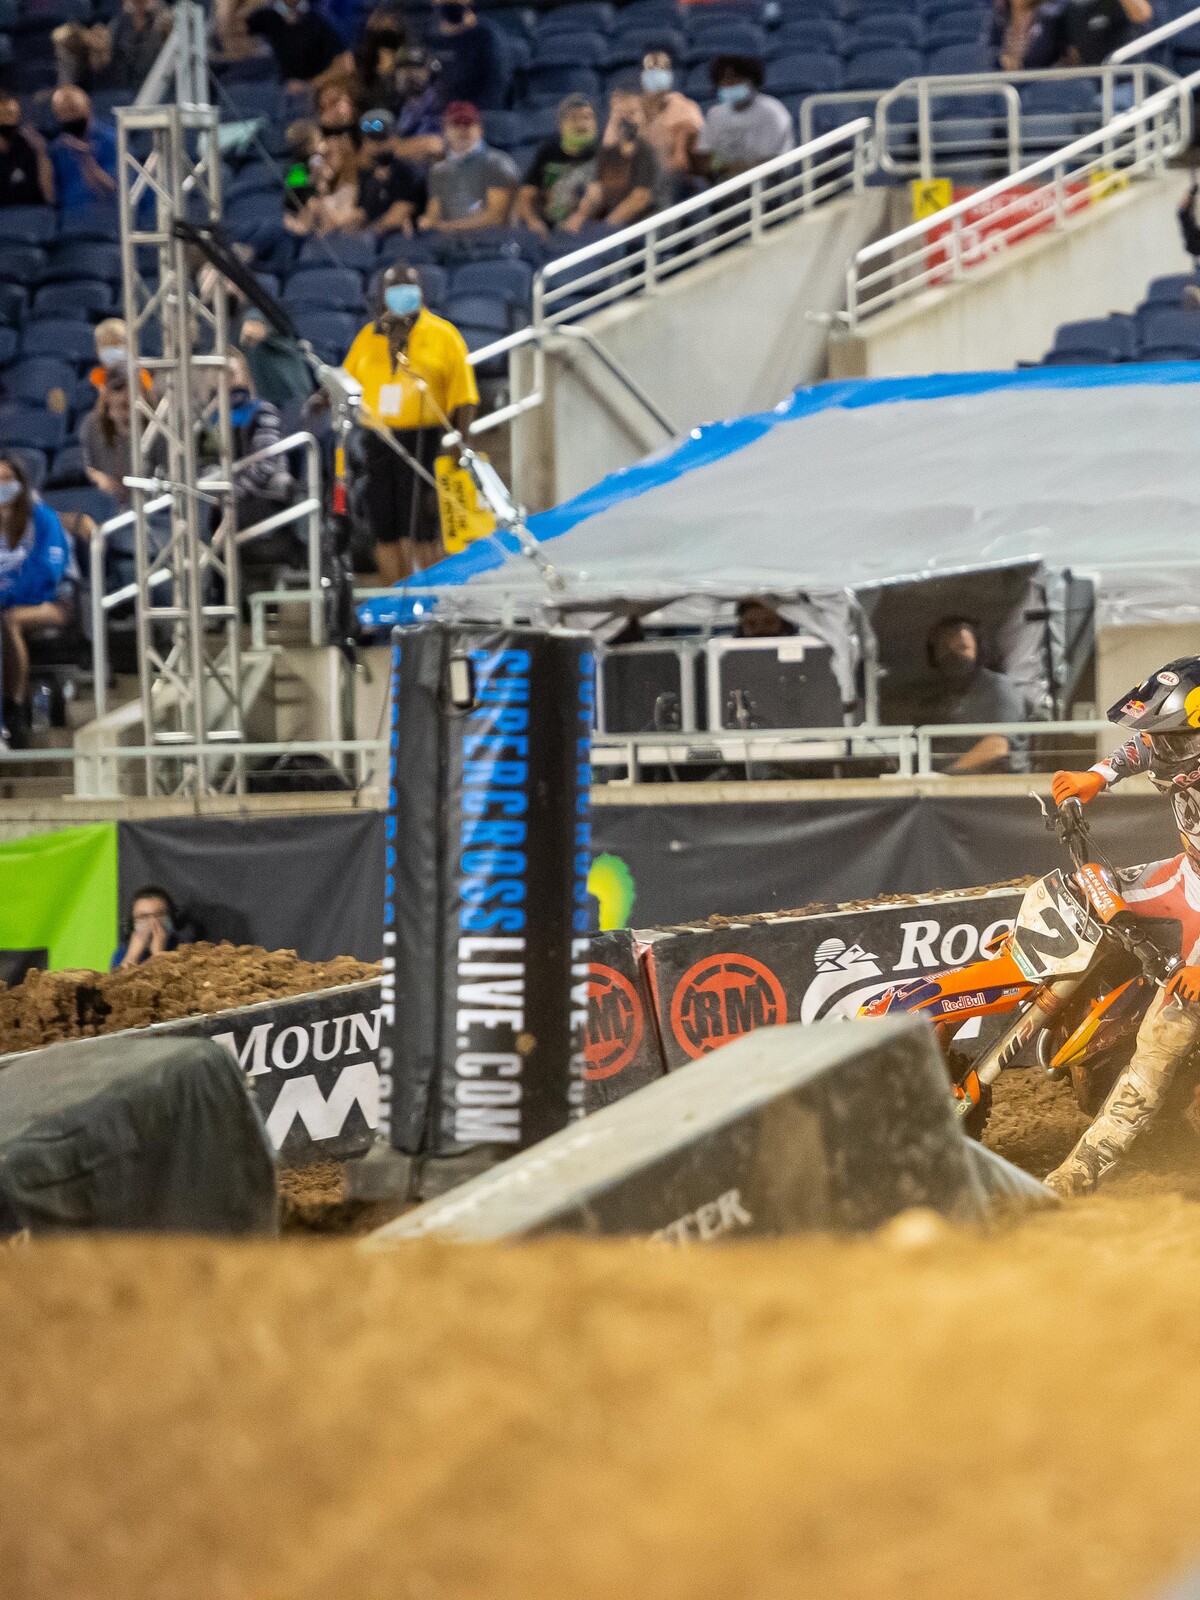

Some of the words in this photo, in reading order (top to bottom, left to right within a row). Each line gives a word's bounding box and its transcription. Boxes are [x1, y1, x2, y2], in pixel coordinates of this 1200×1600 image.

[1159, 673, 1175, 683] BELL
[1085, 868, 1116, 908] RENTHAL
[1015, 907, 1079, 975] 2
[942, 996, 964, 1012] Red
[964, 992, 987, 1007] Bull
